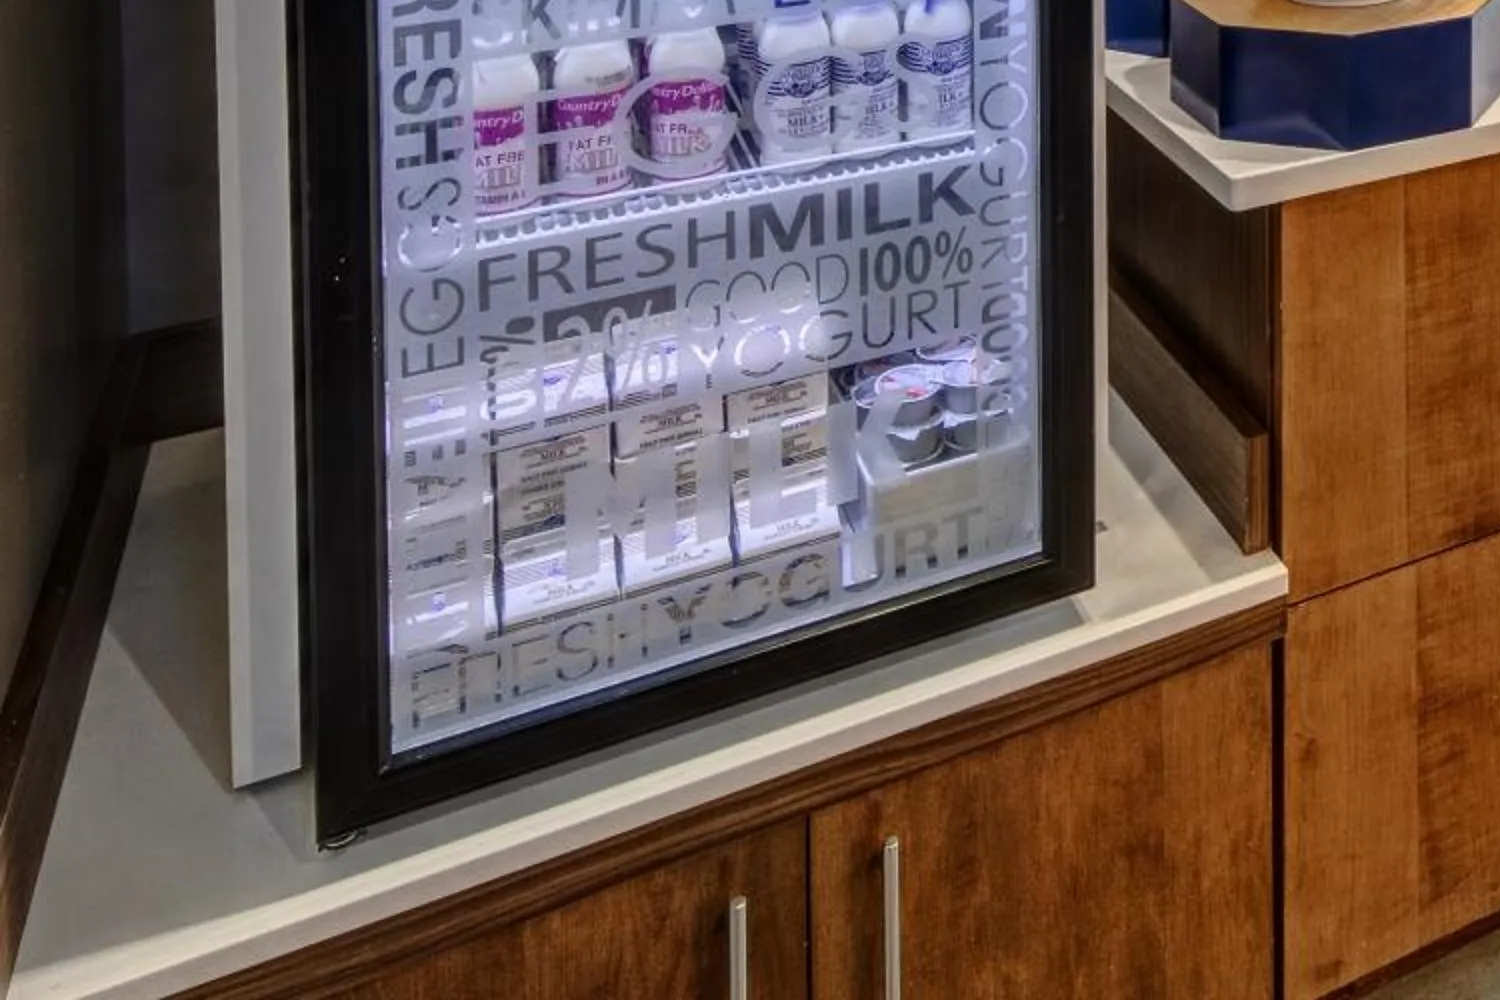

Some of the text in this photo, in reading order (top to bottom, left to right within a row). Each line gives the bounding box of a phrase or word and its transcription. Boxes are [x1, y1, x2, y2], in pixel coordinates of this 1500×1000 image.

[398, 177, 464, 378] EGGS
[478, 163, 977, 313] FRESH MILK
[686, 225, 974, 332] GOOD 100%
[690, 280, 971, 389] YOGURT
